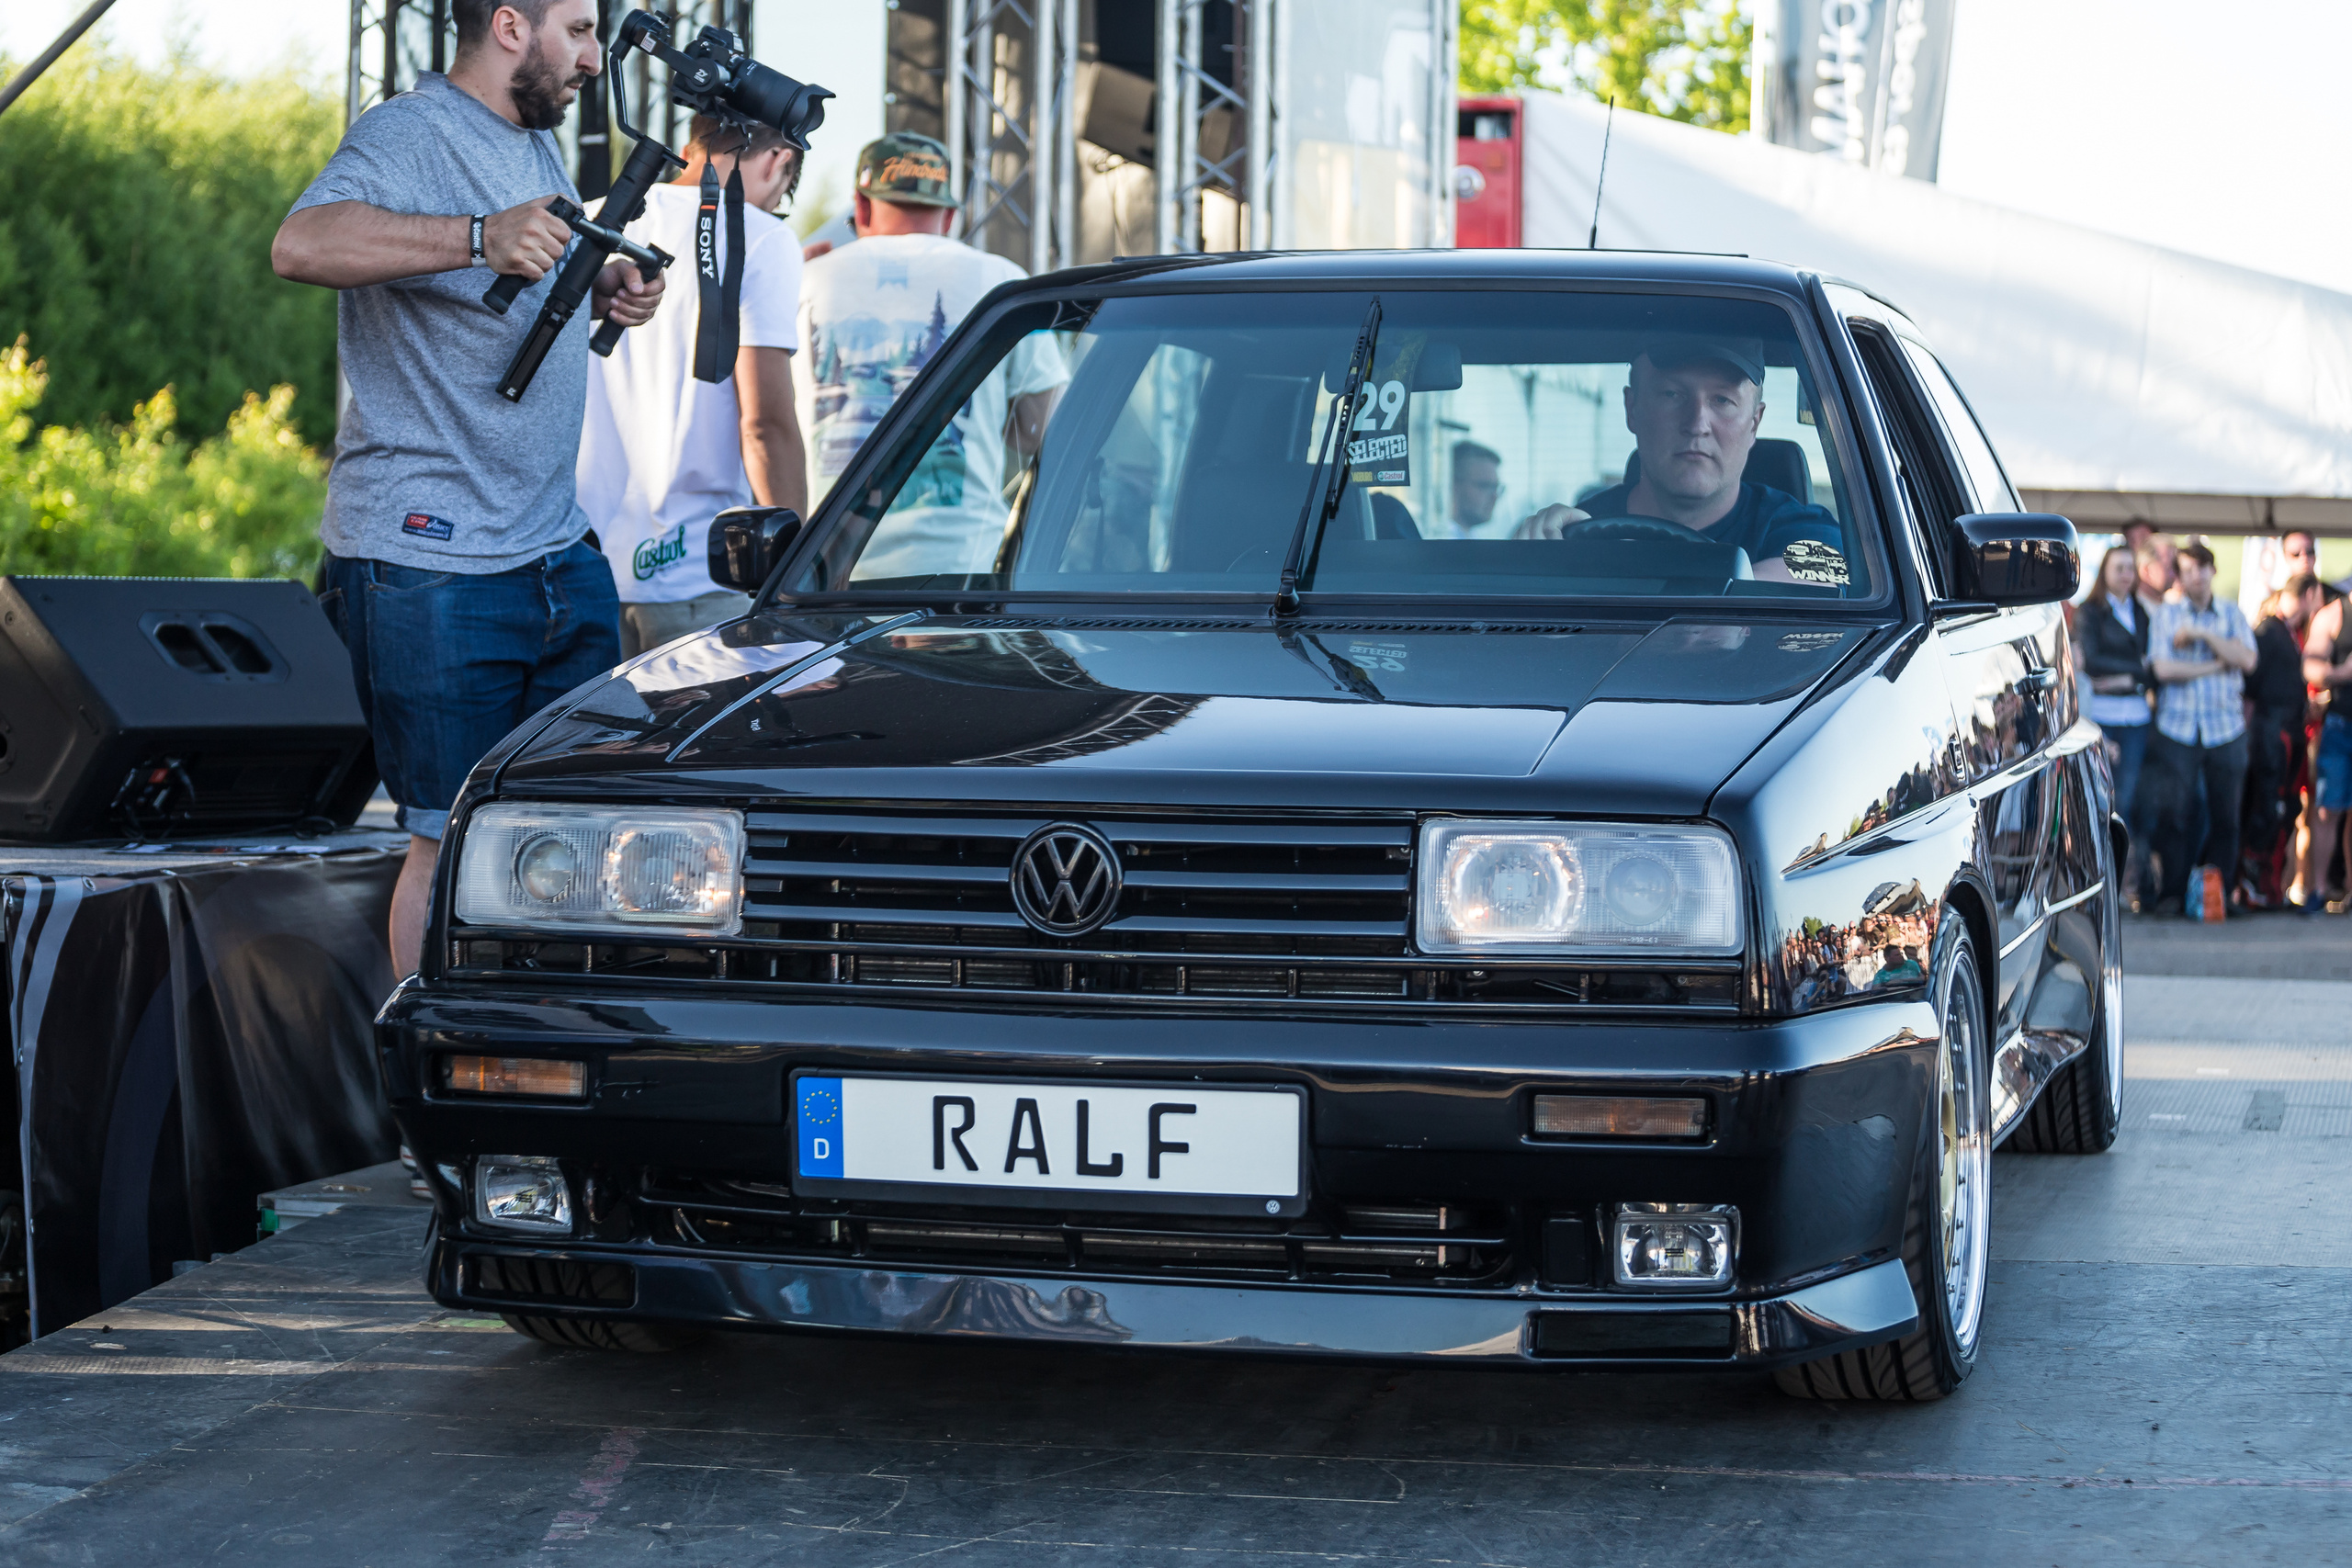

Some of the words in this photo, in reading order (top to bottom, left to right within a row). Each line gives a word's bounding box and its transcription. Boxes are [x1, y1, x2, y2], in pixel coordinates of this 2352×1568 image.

[699, 216, 715, 279] SONY
[1353, 379, 1406, 431] 29
[1348, 434, 1408, 465] SELECTED
[1384, 471, 1404, 480] Castrol
[633, 524, 687, 581] Castrol
[1787, 568, 1851, 585] WINNER
[814, 1137, 830, 1159] D
[932, 1095, 1198, 1179] RALF
